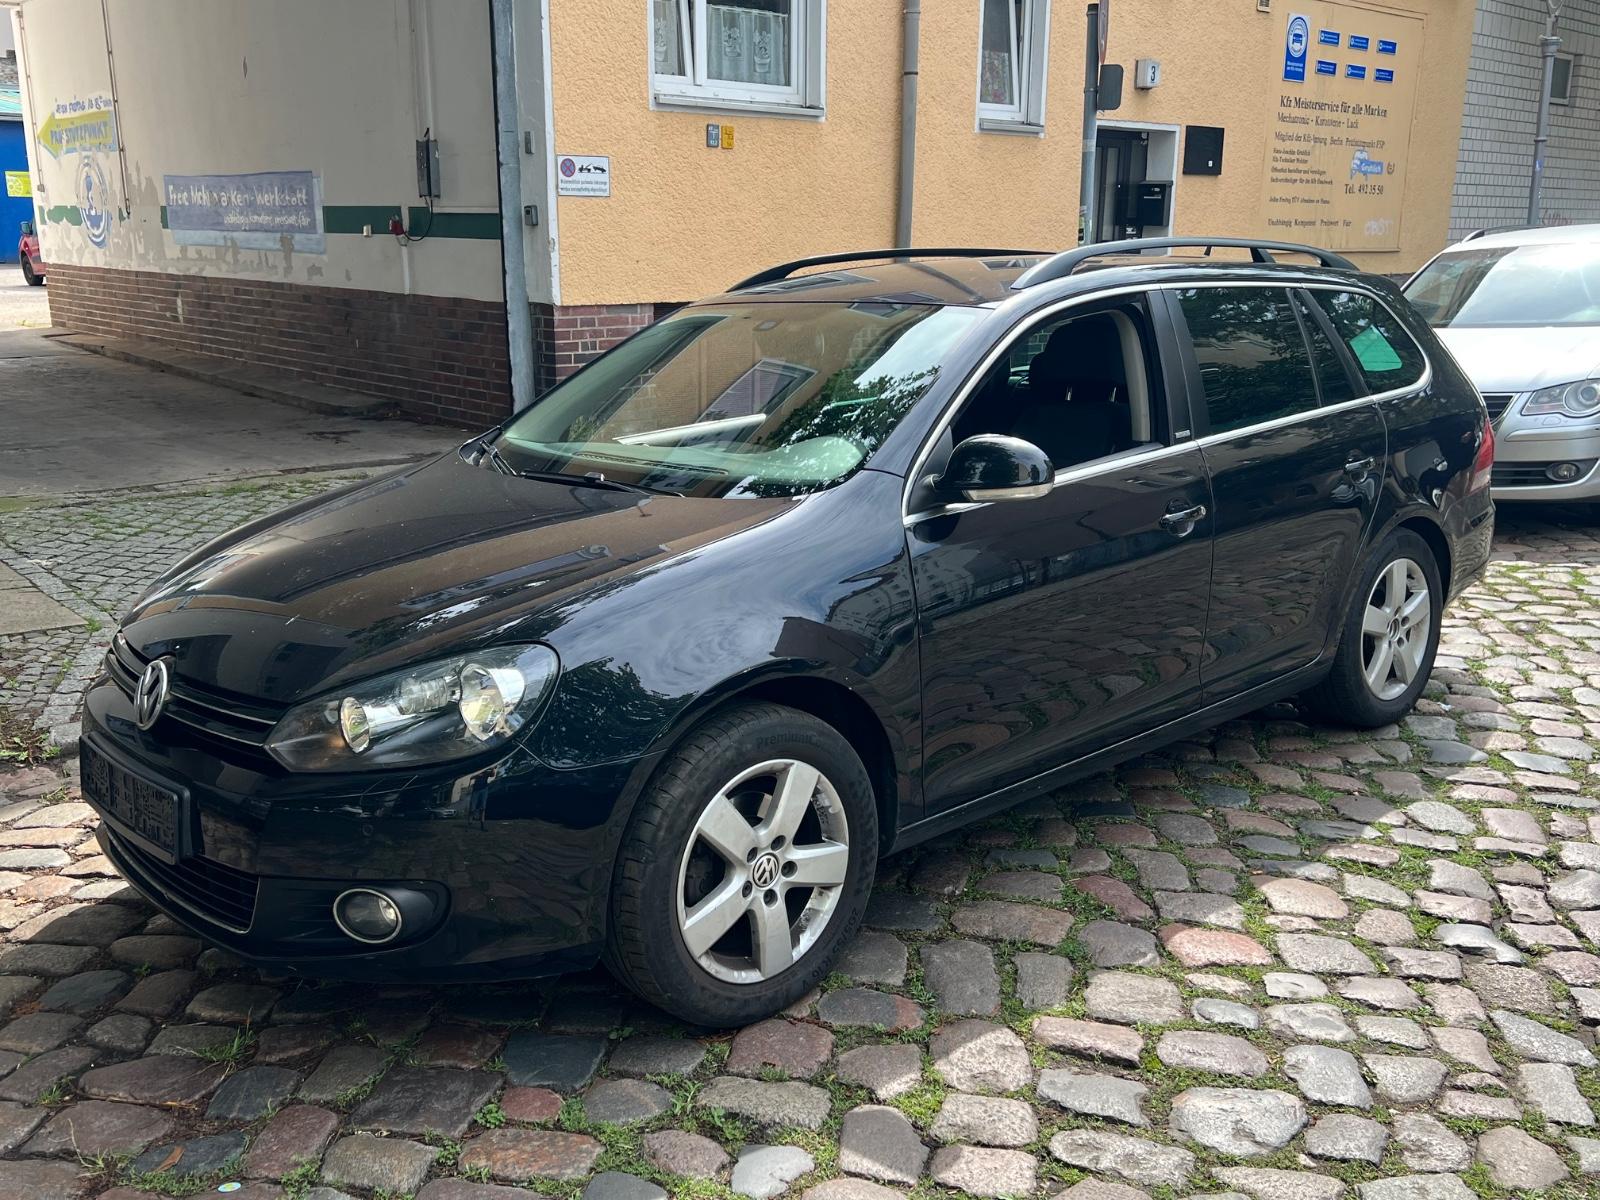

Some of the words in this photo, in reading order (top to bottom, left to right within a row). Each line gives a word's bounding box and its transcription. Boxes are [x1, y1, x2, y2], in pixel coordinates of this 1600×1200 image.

[1150, 66, 1156, 82] 3
[1280, 95, 1292, 108] Kfz
[1293, 97, 1340, 112] Meisterservice
[1341, 101, 1351, 113] für
[1352, 104, 1363, 115] alle
[1364, 104, 1387, 118] Marken
[1346, 118, 1359, 128] Lack
[752, 852, 780, 889] VW
